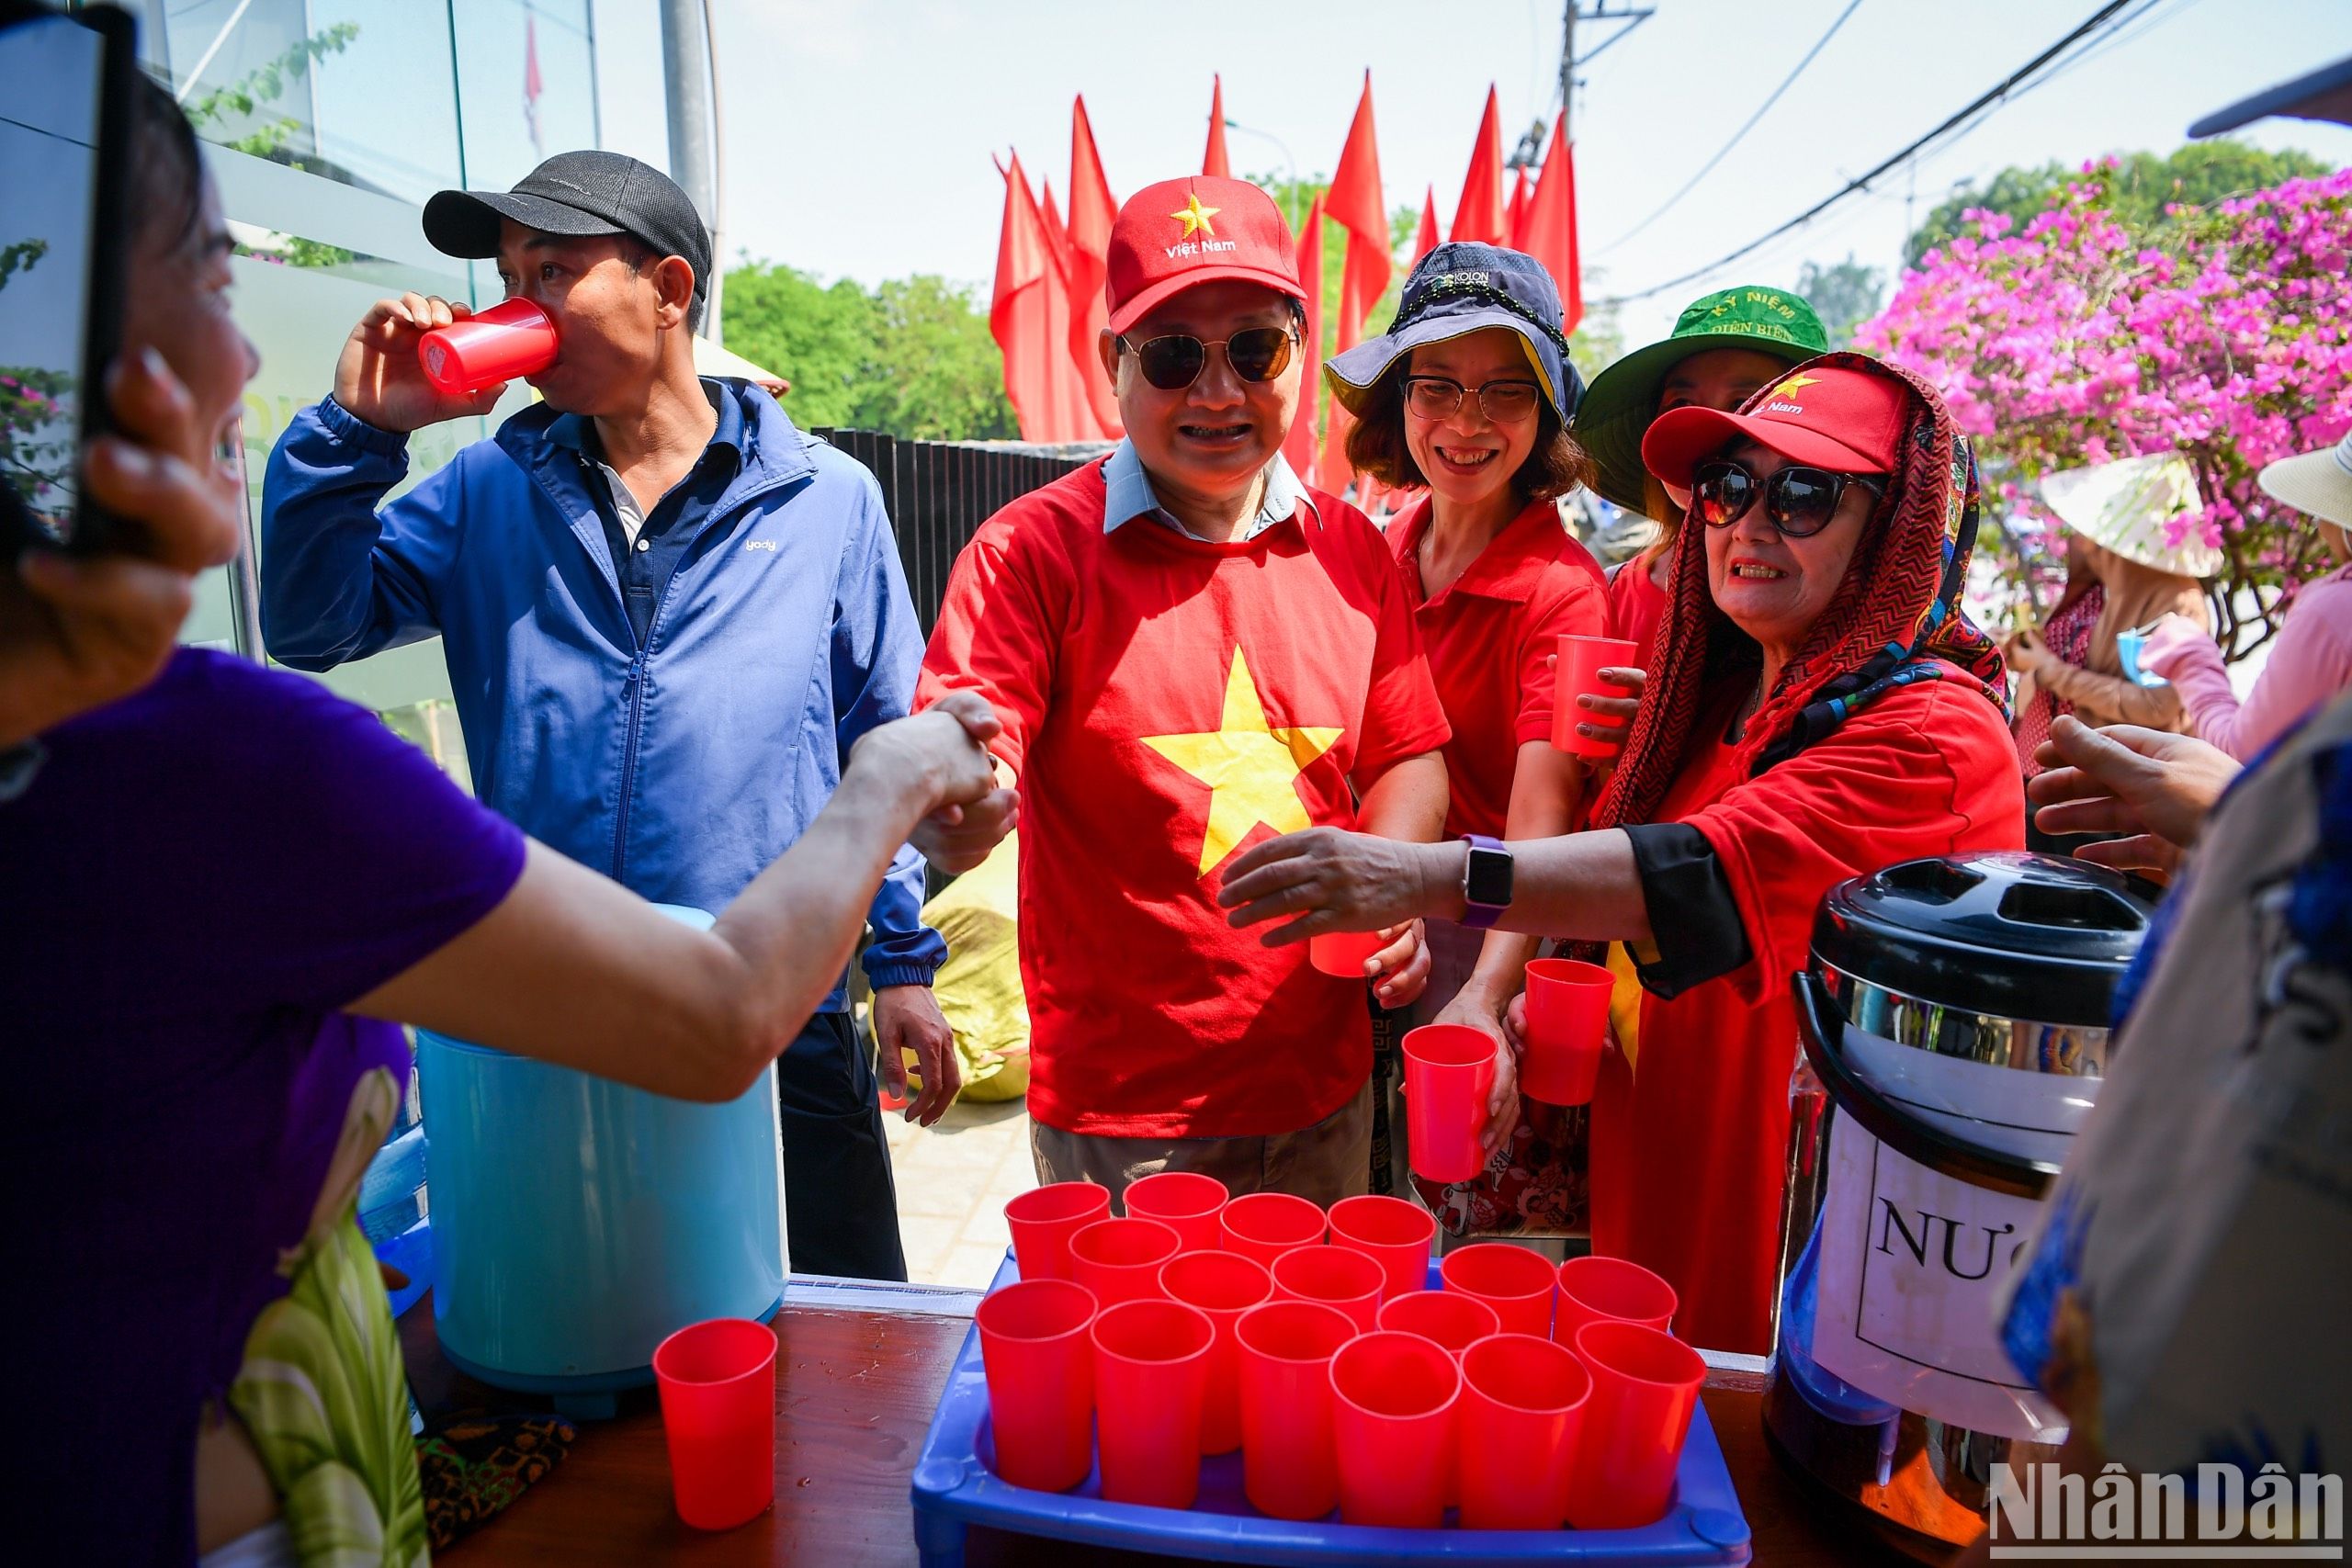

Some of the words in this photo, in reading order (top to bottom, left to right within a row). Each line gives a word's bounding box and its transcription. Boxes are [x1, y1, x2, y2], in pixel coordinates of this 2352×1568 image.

[1165, 243, 1198, 258] Việt
[1202, 240, 1236, 252] Nam
[1454, 272, 1489, 282] KOLON
[1747, 291, 1795, 319] NIỆM
[1767, 402, 1804, 415] Nam
[745, 539, 776, 551] yody
[1876, 1197, 2029, 1280] NƯ
